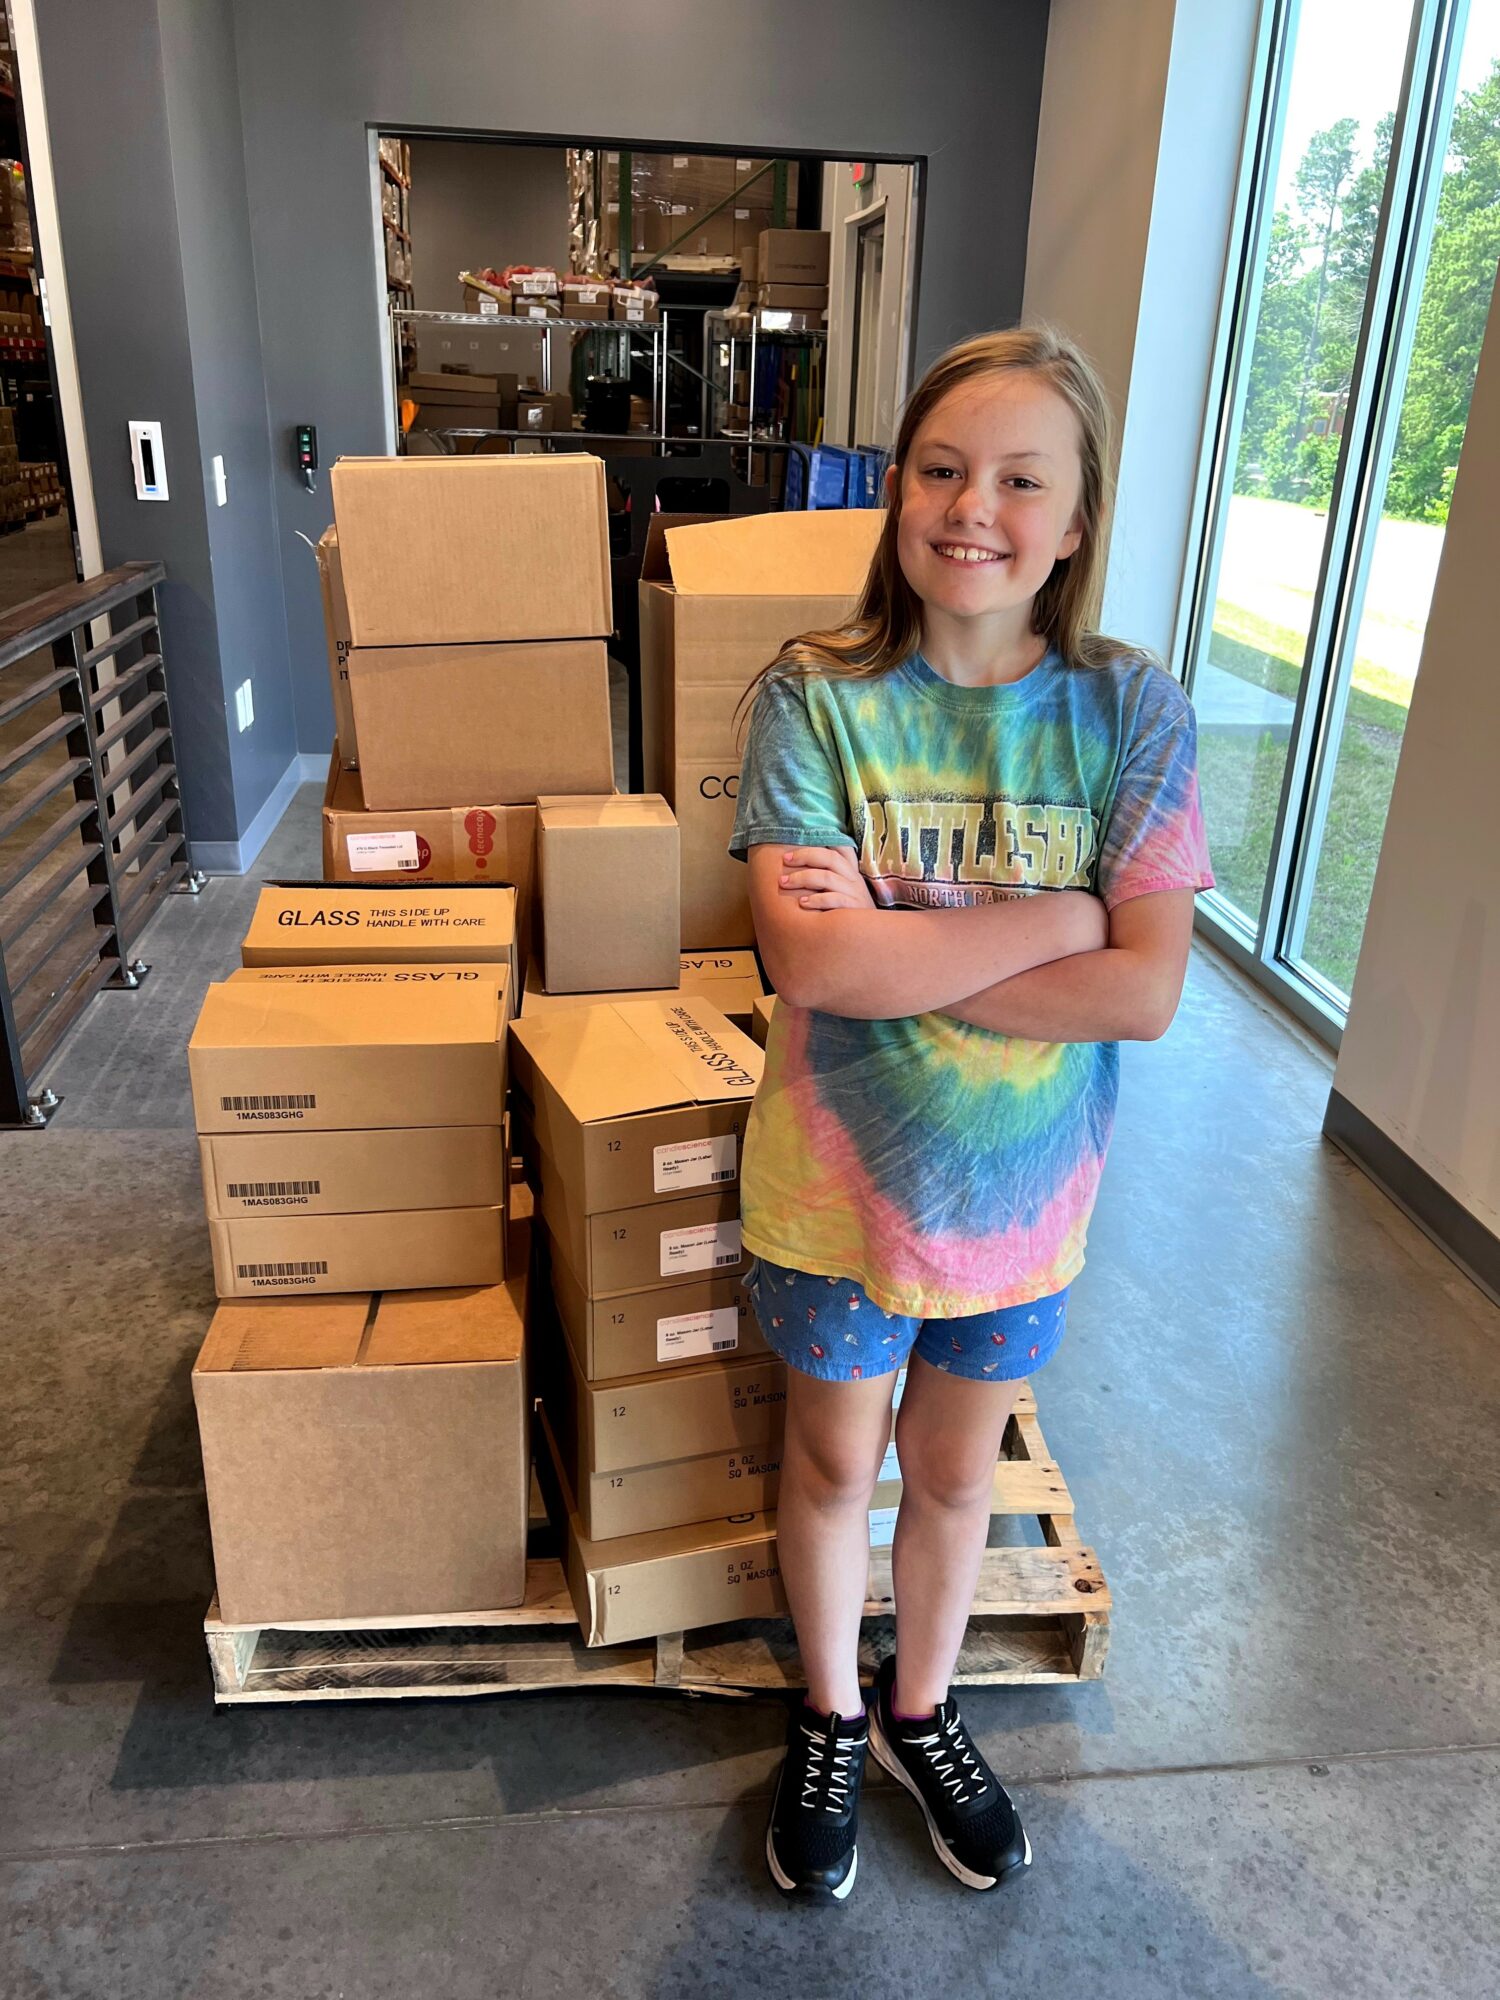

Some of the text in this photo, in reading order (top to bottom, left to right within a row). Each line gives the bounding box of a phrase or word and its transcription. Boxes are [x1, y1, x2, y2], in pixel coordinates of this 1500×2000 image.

[908, 884, 967, 908] NORTH
[278, 910, 361, 926] GLASS
[370, 908, 450, 917] THIS SIDE UP
[366, 918, 486, 928] HANDLE WITH CARE
[394, 972, 479, 981] GLASS
[700, 1052, 756, 1087] GLASS
[236, 1111, 304, 1120] 1MAS083GHG
[607, 1140, 622, 1152] 12
[242, 1196, 309, 1206] 1MAS083GHG
[612, 1229, 627, 1240] 12
[252, 1276, 316, 1286] 1MAS083GHG
[611, 1313, 626, 1325] 12
[747, 1383, 760, 1394] OZ
[753, 1391, 787, 1405] MASON
[612, 1406, 626, 1418] 12
[728, 1454, 755, 1468] 8 OZ
[747, 1461, 780, 1475] MASON
[610, 1477, 624, 1489] 12
[727, 1560, 754, 1574] 8 OZ
[746, 1567, 779, 1582] MASON
[607, 1584, 622, 1596] 12
